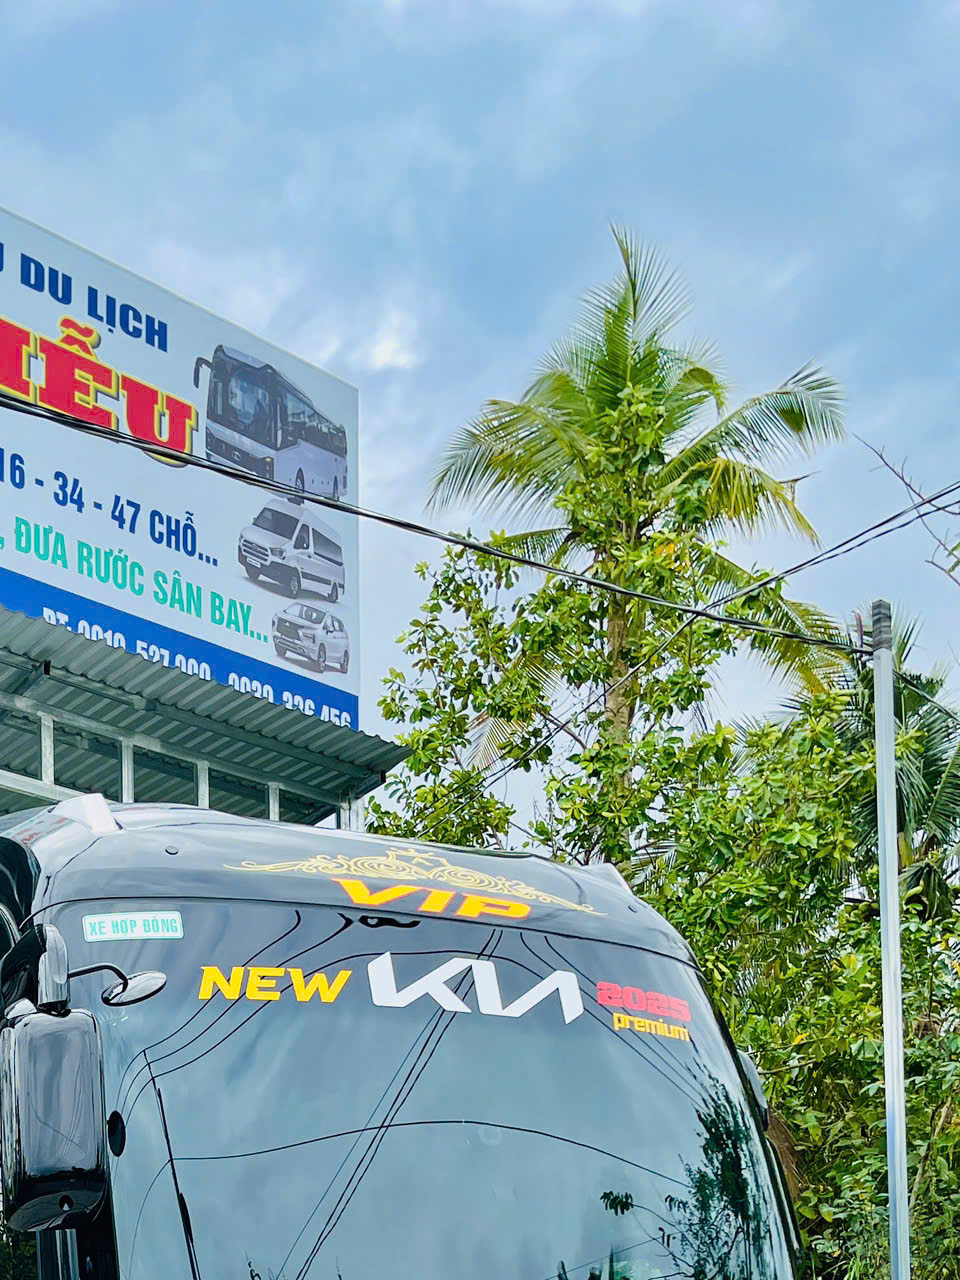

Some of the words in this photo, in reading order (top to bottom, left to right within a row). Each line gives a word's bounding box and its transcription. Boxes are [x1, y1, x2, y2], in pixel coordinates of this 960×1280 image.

[20, 252, 73, 305] DU
[87, 286, 168, 353] LỊCH
[53, 470, 85, 513] 34
[111, 494, 140, 534] 47
[14, 516, 69, 570] ĐƯA
[77, 540, 145, 596] RƯỚC
[153, 570, 202, 619] SÂN
[330, 877, 533, 920] VIP
[89, 920, 107, 936] XE
[198, 965, 352, 1003] NEW
[596, 981, 691, 1022] 2025
[612, 1012, 690, 1042] premium
